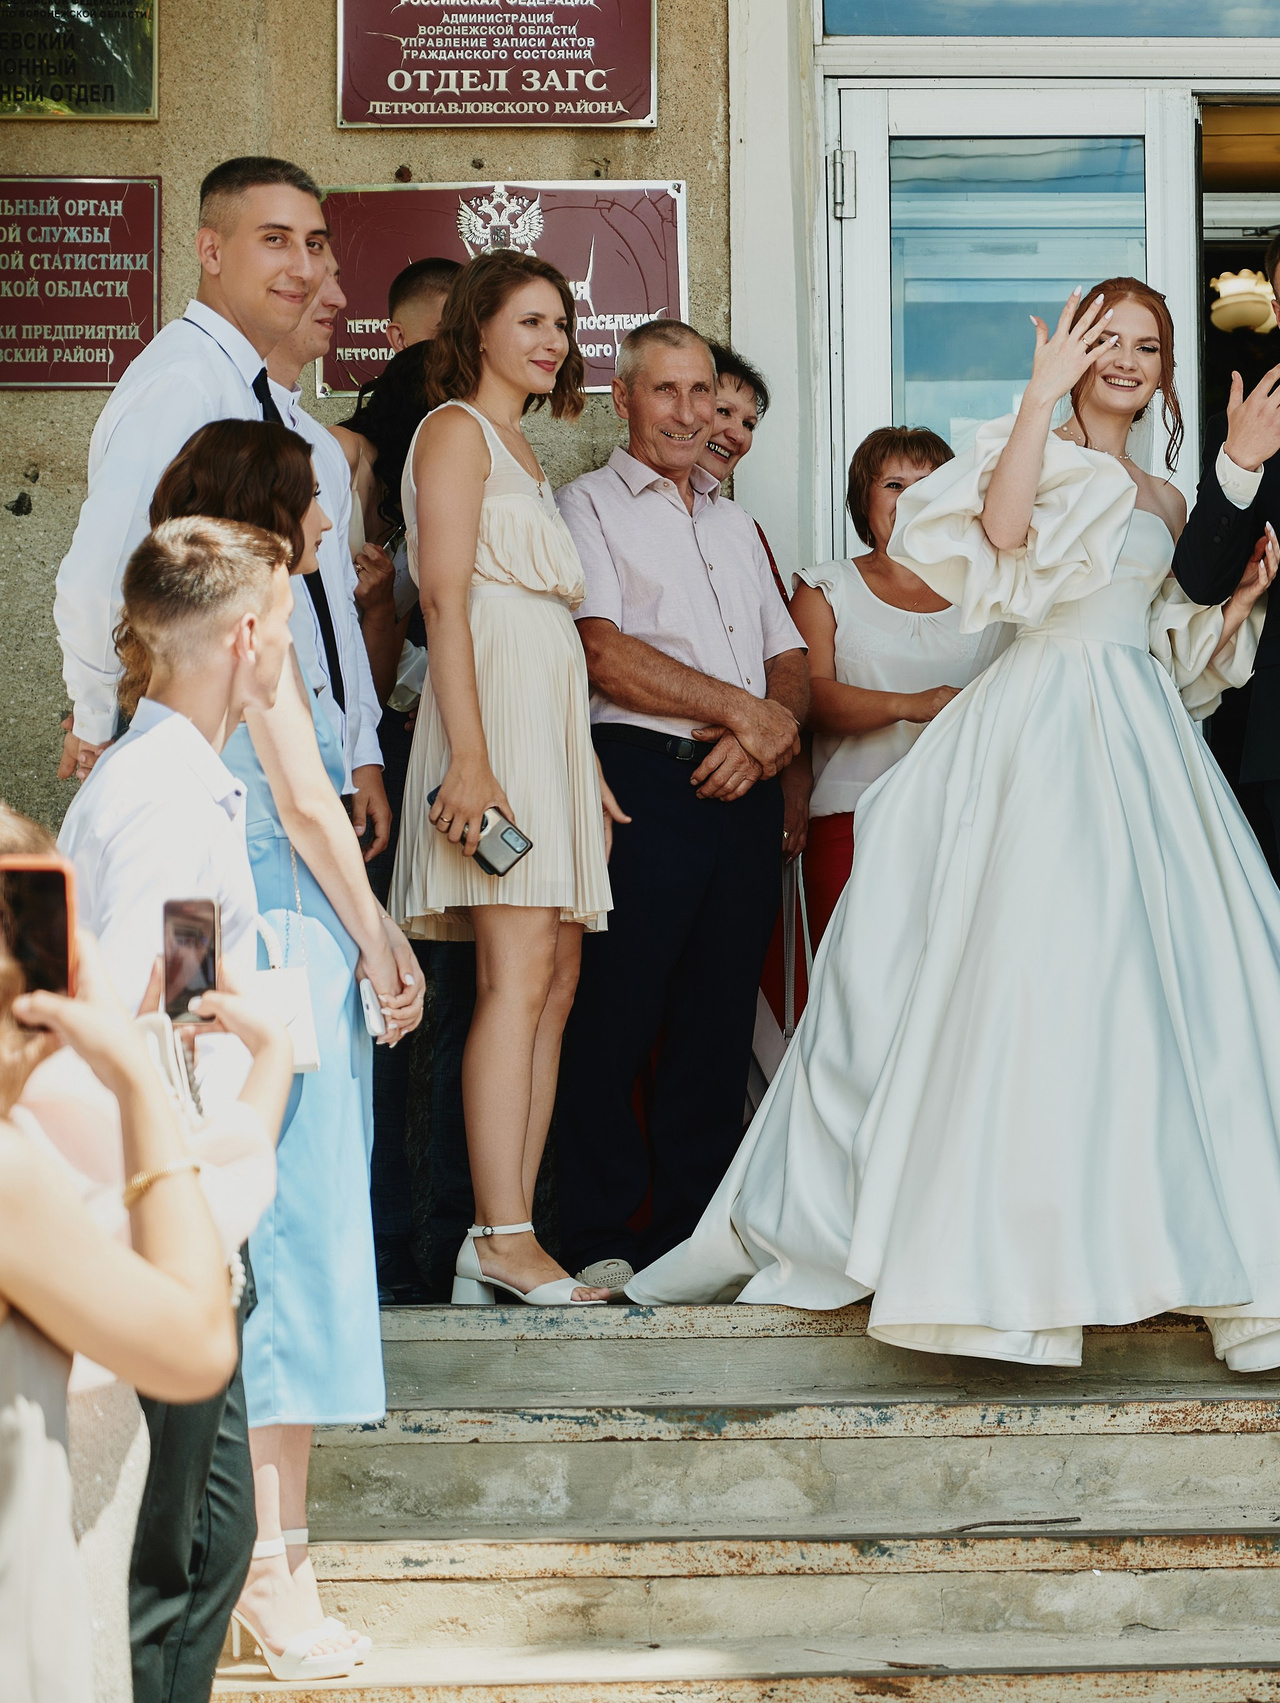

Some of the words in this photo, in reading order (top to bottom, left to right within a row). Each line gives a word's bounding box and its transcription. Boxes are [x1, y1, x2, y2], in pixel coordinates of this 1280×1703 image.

[100, 10, 147, 18] ОБЛАСТИ
[442, 13, 554, 24] АДМИНИСТРАЦИЯ
[418, 23, 514, 35] ВОРОНЕЖСКОЙ
[519, 25, 577, 35] ОБЛАСТИ
[400, 37, 489, 47] УПРАВЛЕНИЕ
[493, 37, 546, 47] ЗАПИСИ
[551, 37, 596, 47] АКТОВ
[403, 49, 508, 60] ГРАЖДАНСКОГО
[513, 49, 592, 60] СОСТОЯНИЯ
[0, 54, 77, 76] ОННЫЙ
[387, 69, 509, 96] ОТДЕЛ
[521, 69, 607, 92] ЗАГС
[50, 84, 115, 106] ОТДЕЛ
[369, 101, 549, 114] ПЕТРОПАВЛОВСКОГО
[555, 99, 627, 114] РАЙОНА
[0, 196, 59, 216] ЬНЫЙ
[65, 200, 123, 216] ОРГАН
[27, 226, 110, 243] СЛУЖБЫ
[30, 253, 148, 270] СТАТИСТИКИ
[45, 281, 128, 297] ОБЛАСТИ
[22, 323, 140, 341] ПРЕДПРИЯТИЙ
[53, 345, 114, 365] РАЙОН)
